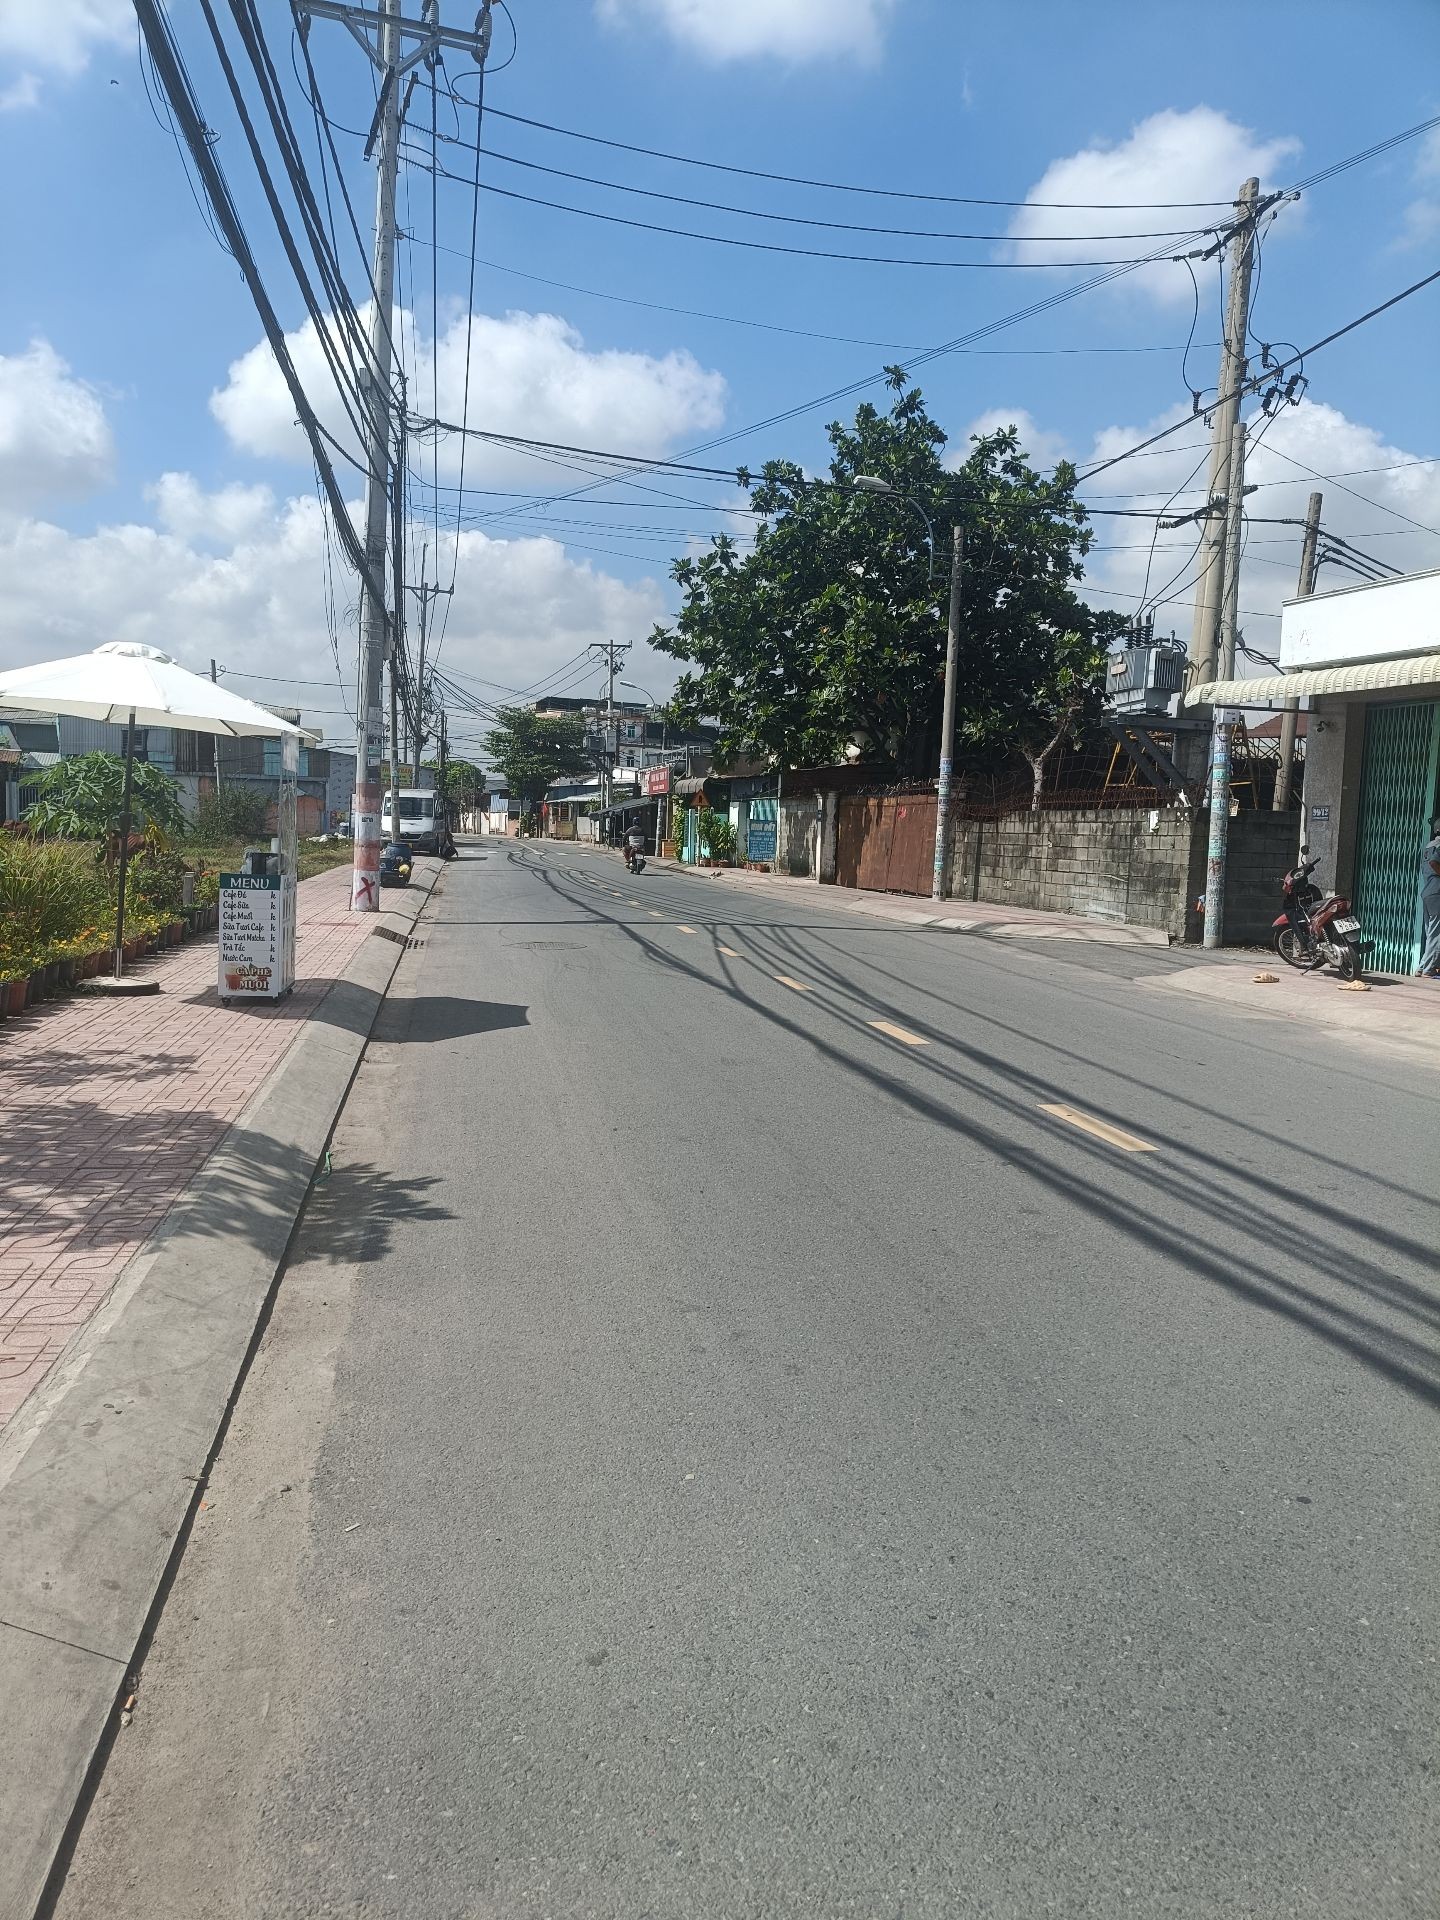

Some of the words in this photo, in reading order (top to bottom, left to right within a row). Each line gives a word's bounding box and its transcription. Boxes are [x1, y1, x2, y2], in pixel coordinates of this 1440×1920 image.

[230, 878, 269, 889] MENU
[223, 890, 237, 900] Cafe
[270, 891, 277, 899] k
[223, 901, 237, 910] Cafe
[270, 902, 276, 910] k
[223, 912, 237, 922] Cafe
[270, 912, 276, 921] k
[251, 923, 265, 933] Cafe
[270, 923, 276, 931] k
[270, 933, 276, 942] k
[223, 943, 233, 951] Trà
[270, 944, 276, 952] k
[239, 954, 253, 962] Cam
[269, 955, 275, 963] k
